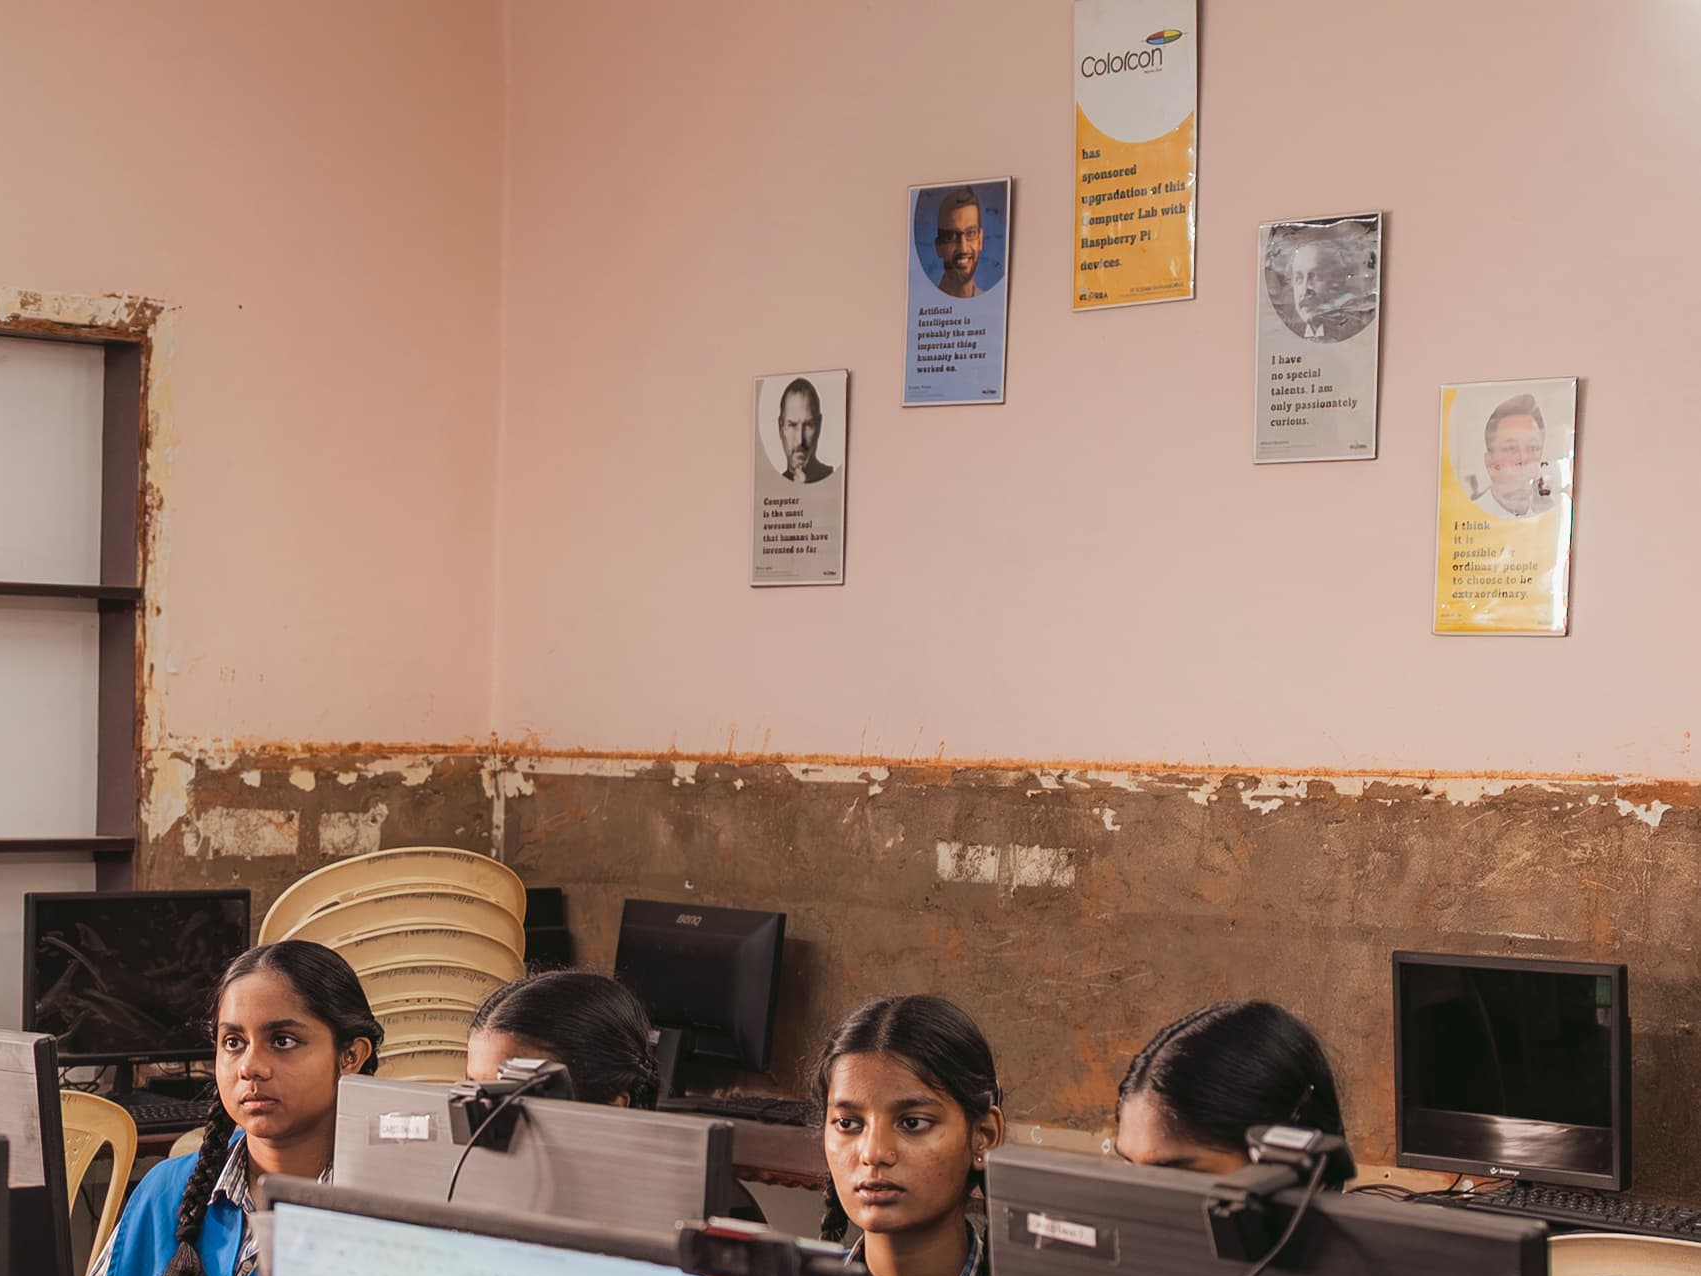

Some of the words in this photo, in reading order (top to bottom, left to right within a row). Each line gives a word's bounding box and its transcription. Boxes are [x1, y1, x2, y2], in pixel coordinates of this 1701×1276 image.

[1081, 47, 1163, 78] Colorcon
[1082, 149, 1100, 160] has
[1082, 164, 1137, 184] sponsored
[1081, 187, 1148, 206] upgradation
[1152, 183, 1162, 195] of
[1165, 180, 1186, 193] this
[1082, 210, 1135, 227] omputer
[1138, 206, 1158, 219] Lab
[1161, 203, 1186, 216] with
[1081, 233, 1137, 249] Raspberry
[1139, 229, 1151, 241] Pi
[919, 306, 953, 316] Artificial
[918, 319, 962, 328] Intelligence
[917, 330, 951, 341] probably
[952, 329, 965, 337] the
[967, 328, 986, 336] most
[917, 342, 955, 352] important
[957, 340, 977, 350] thing
[917, 353, 952, 362] humanity
[954, 351, 968, 360] has
[969, 352, 986, 360] ever
[1271, 355, 1276, 365] I
[1279, 354, 1302, 364] have
[917, 365, 945, 374] worked
[1271, 372, 1284, 381] no
[1286, 367, 1321, 382] special
[1271, 386, 1308, 396] talents.
[1311, 383, 1315, 394] I
[1318, 384, 1333, 393] am
[1270, 401, 1293, 413] only
[1295, 396, 1358, 413] passionately
[1270, 416, 1309, 427] curious.
[763, 497, 800, 508] Computer
[763, 509, 770, 518] is
[771, 509, 783, 518] the
[785, 509, 804, 518] most
[763, 522, 797, 530] awesome
[798, 520, 813, 529] tool
[1461, 521, 1491, 531] think
[763, 534, 779, 543] that
[780, 534, 809, 542] humans
[811, 532, 828, 541] have
[1454, 535, 1462, 545] it
[763, 545, 795, 555] invented
[1453, 547, 1497, 560] possible
[1452, 576, 1464, 585] to
[1466, 575, 1503, 585] choose
[1506, 576, 1517, 585] to
[1451, 588, 1529, 601] extraordinary.
